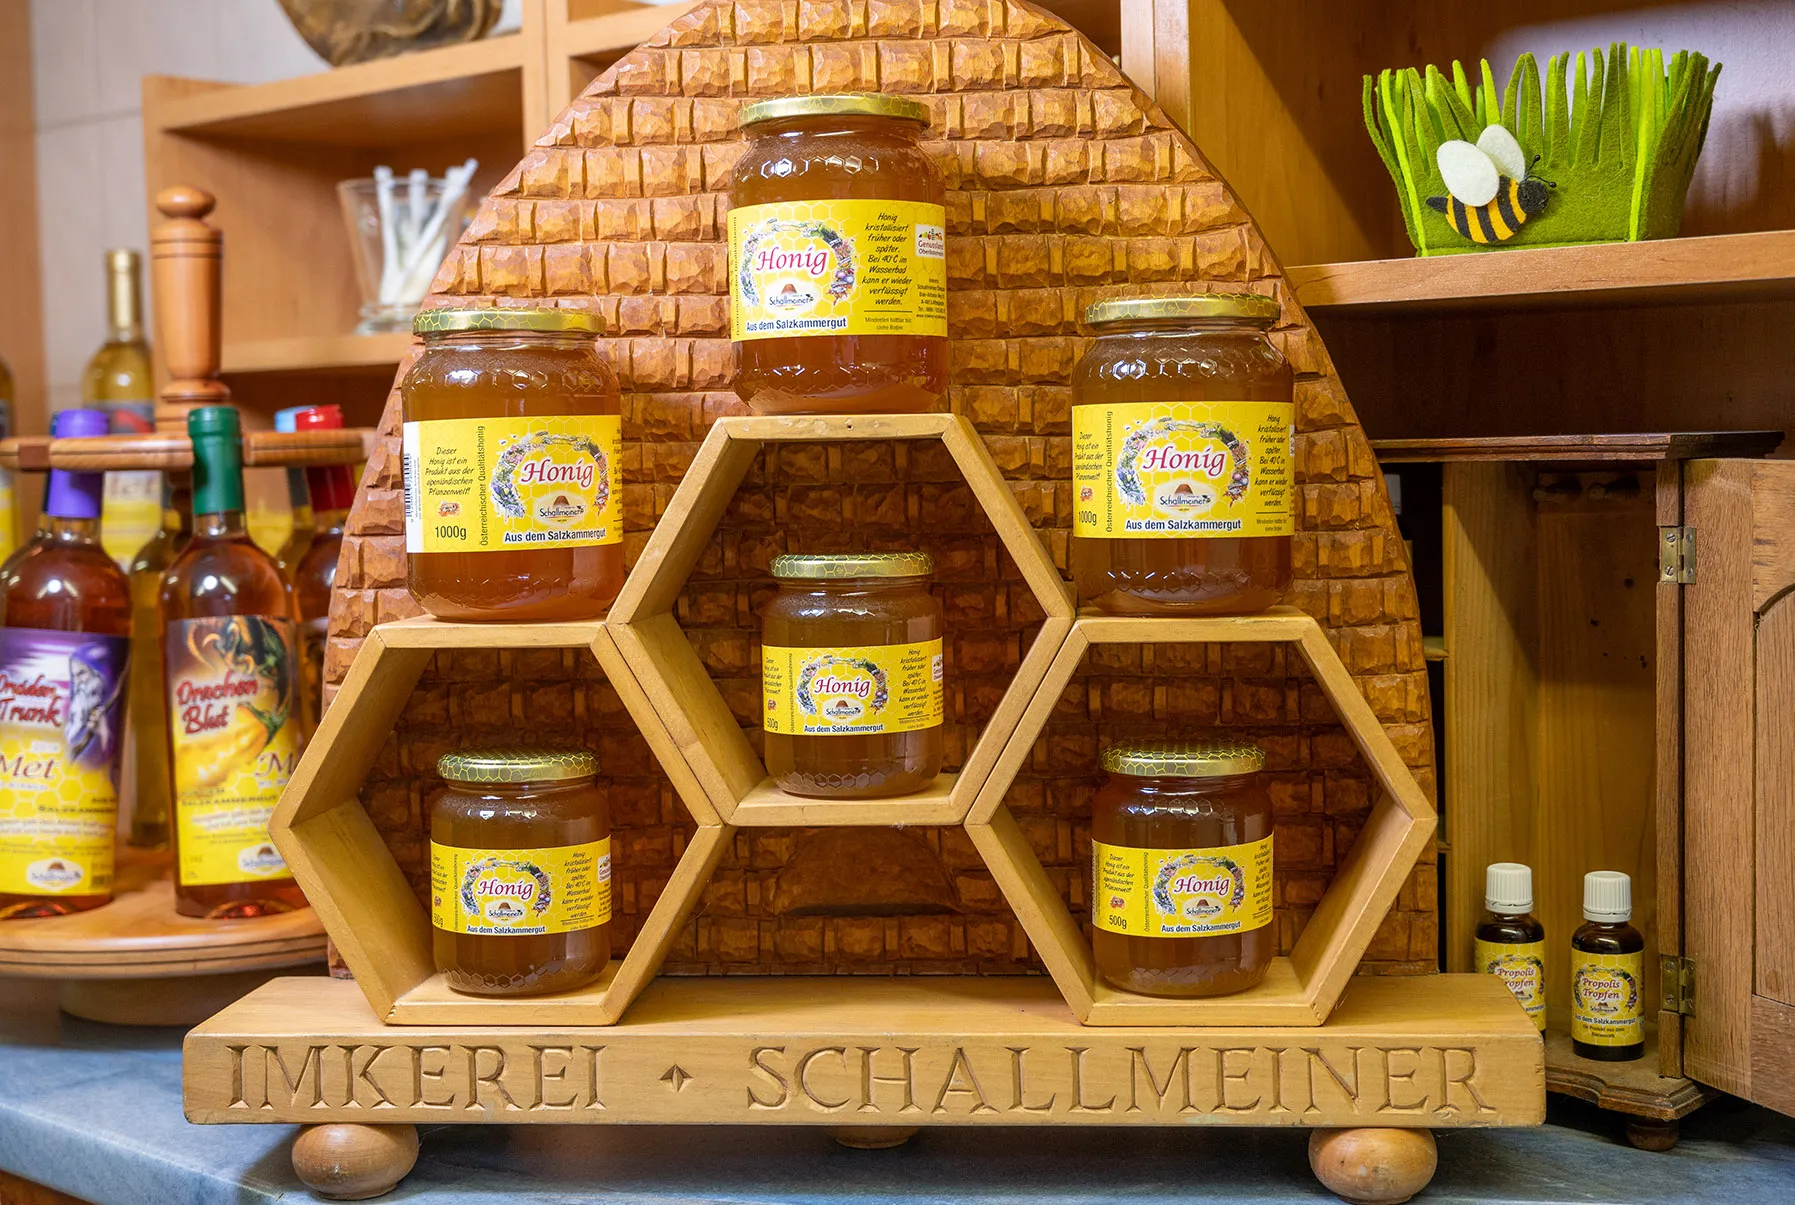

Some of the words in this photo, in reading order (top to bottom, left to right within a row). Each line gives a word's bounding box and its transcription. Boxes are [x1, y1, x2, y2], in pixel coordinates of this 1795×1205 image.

[877, 213, 897, 223] Honig
[865, 223, 908, 232] kristallisiert
[867, 233, 890, 242] früher
[875, 245, 900, 254] später.
[756, 246, 827, 275] Honig
[868, 255, 881, 263] Bei
[869, 266, 907, 274] Wasserbad
[862, 276, 879, 284] kann
[891, 277, 912, 285] wieder
[869, 287, 908, 297] verflüssigt
[875, 297, 902, 306] werden.
[747, 322, 757, 331] Aus
[759, 321, 774, 330] dem
[776, 318, 846, 329] Salzkammergut
[1105, 411, 1113, 467] Qualitätshonig
[436, 447, 456, 455] Dieser
[477, 426, 486, 481] Qualitätshonig
[429, 458, 445, 467] Honig
[446, 457, 456, 465] ist
[1143, 446, 1225, 476] Honig
[462, 466, 474, 474] der
[521, 459, 593, 488] Honig
[1160, 495, 1206, 505] Schallmeiner
[480, 484, 488, 546] Österreichischer
[540, 506, 580, 517] Schallmeiner
[1079, 511, 1097, 526] 1000g
[1126, 520, 1142, 529] Aus
[1145, 520, 1165, 529] dem
[1168, 519, 1241, 531] Salzkammergut
[435, 526, 467, 540] 1000g
[505, 533, 522, 542] Aus
[525, 532, 545, 541] dem
[548, 528, 606, 540] Salzkammergut
[176, 670, 258, 705] Drachen
[814, 677, 870, 697] Honig
[0, 696, 61, 727] Trunk
[183, 704, 229, 734] Blut
[832, 724, 883, 732] Salzkammergut
[0, 755, 54, 778] Met
[478, 879, 533, 900] Honig
[1174, 876, 1230, 896] Honig
[1109, 914, 1127, 929] 500g
[1192, 921, 1241, 932] Salzkammergut
[494, 926, 545, 934] Salzkammergut
[1498, 967, 1534, 980] Propolis
[1504, 978, 1534, 989] ropfen
[1582, 978, 1620, 990] Propolis
[1583, 988, 1620, 1001] Tropfen
[225, 1044, 607, 1112] IMKEREI
[747, 1044, 1497, 1114] SCHALLMEINER
